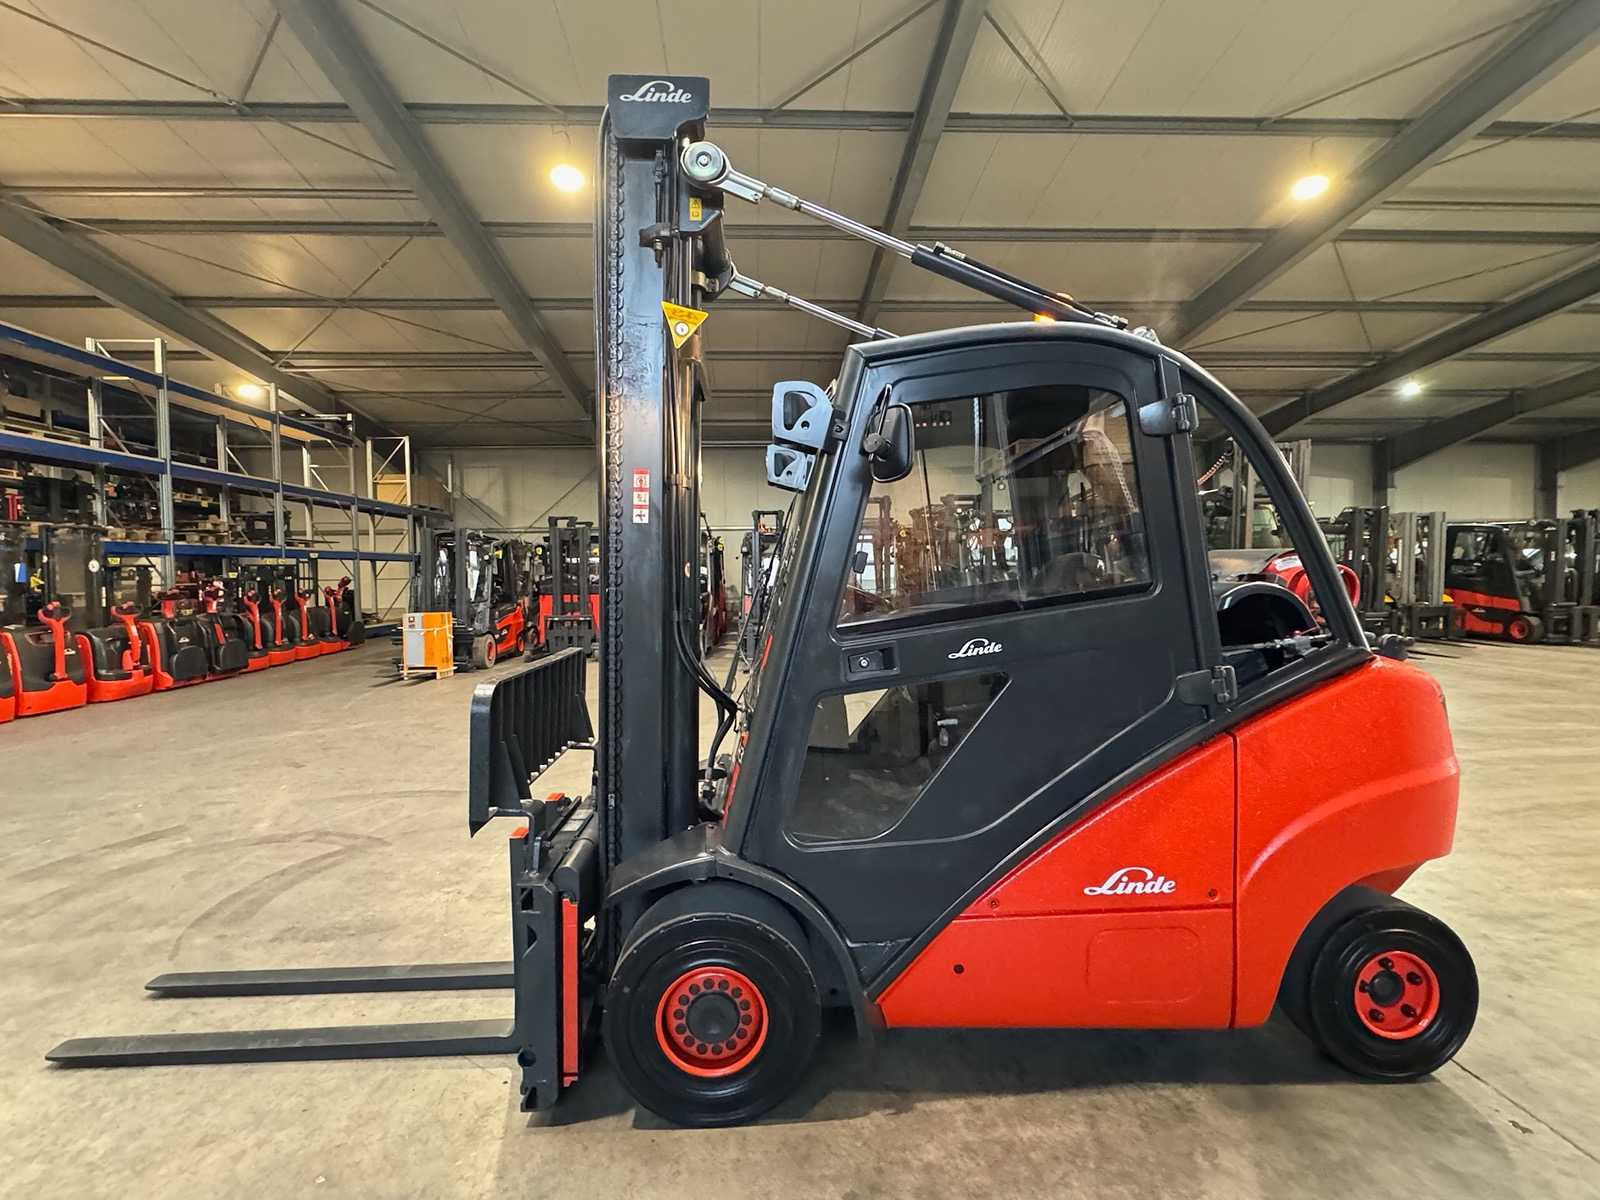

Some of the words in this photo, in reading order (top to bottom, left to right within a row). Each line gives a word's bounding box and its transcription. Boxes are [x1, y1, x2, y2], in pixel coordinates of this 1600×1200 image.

[619, 80, 692, 103] Linde
[948, 638, 1003, 659] Linde
[1083, 866, 1177, 896] Linde
